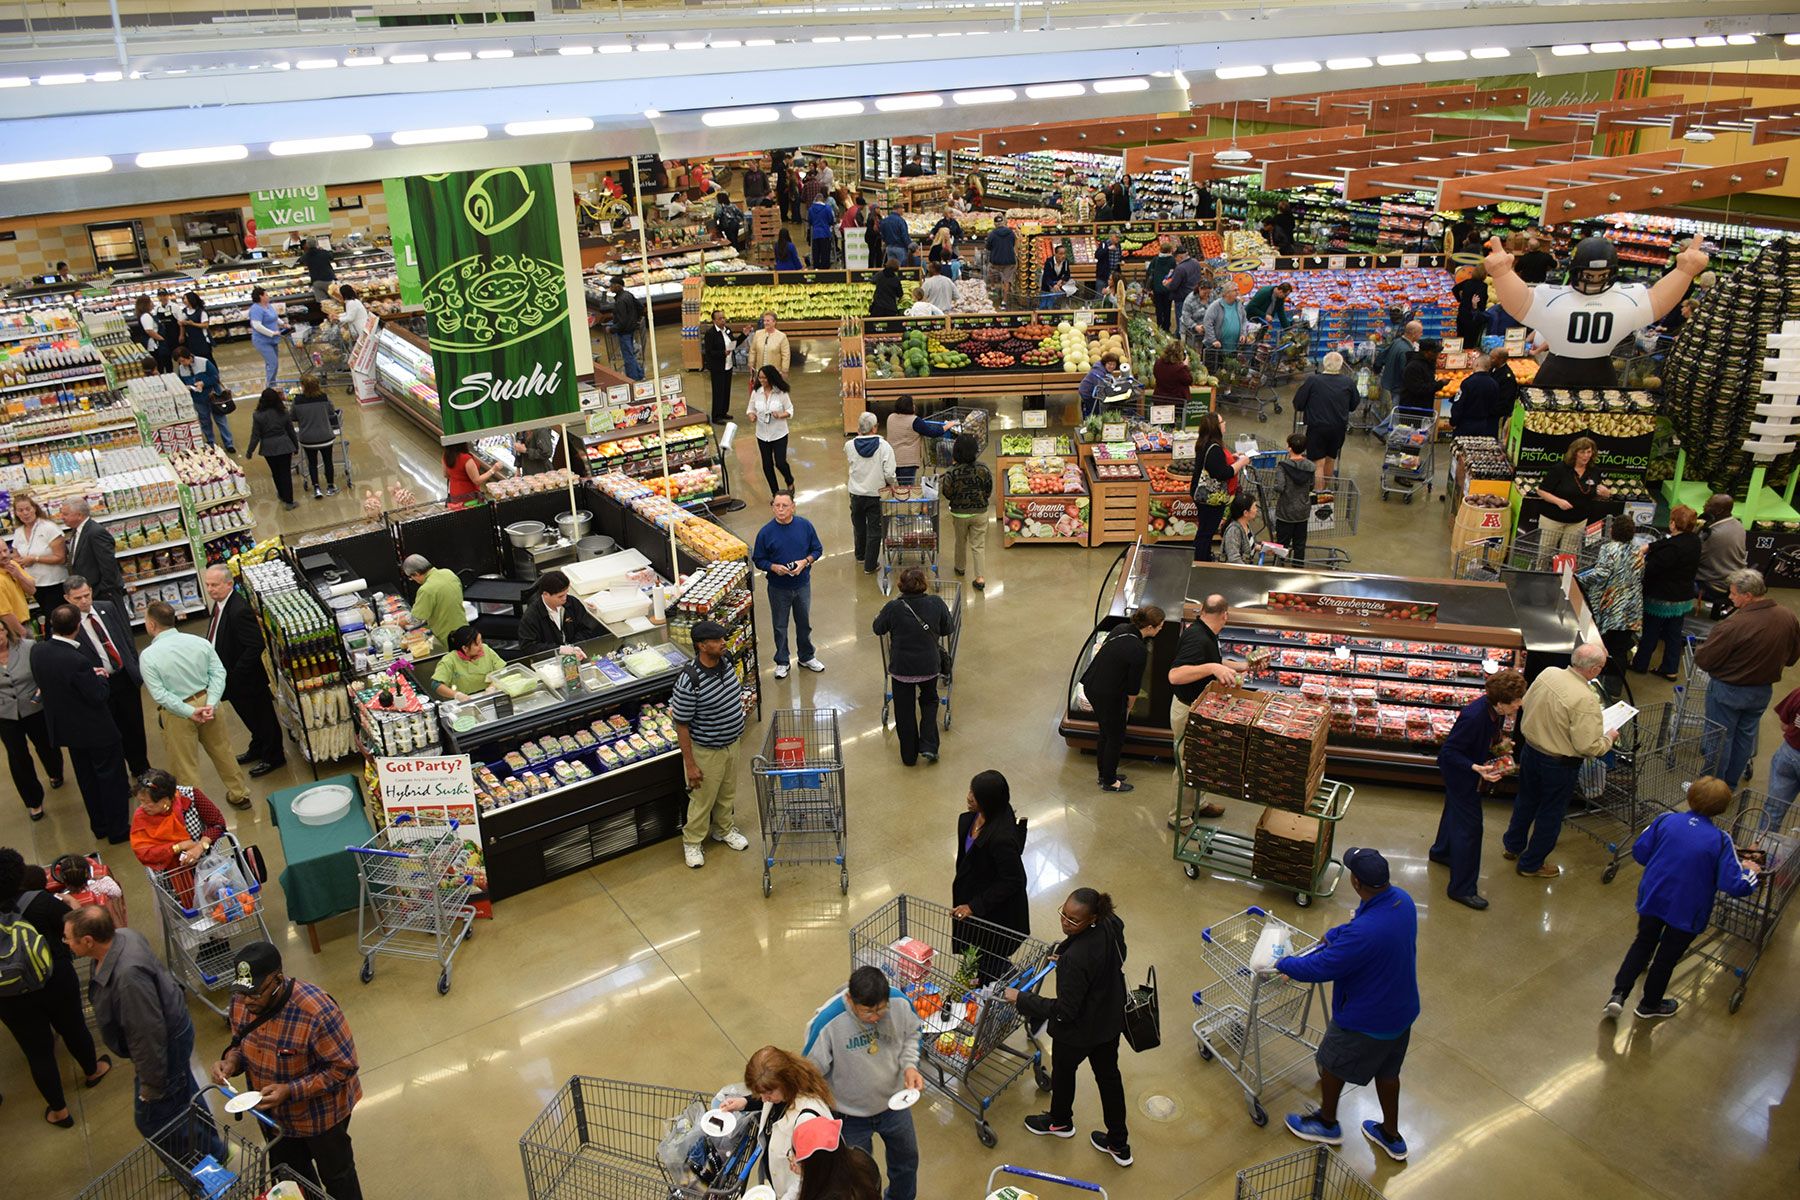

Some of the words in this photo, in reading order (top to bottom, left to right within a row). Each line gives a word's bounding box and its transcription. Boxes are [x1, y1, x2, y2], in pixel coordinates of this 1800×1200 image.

[268, 205, 316, 225] Well
[1567, 311, 1614, 344] 00
[448, 360, 563, 411] Sushi
[1520, 451, 1565, 462] PISTACH
[1594, 454, 1649, 466] STACHIOS
[183, 491, 196, 529] LIVING
[1027, 501, 1066, 514] Organic
[1171, 500, 1197, 513] Orga
[1317, 596, 1386, 610] Strawberries
[386, 761, 413, 772] Got
[416, 759, 462, 774] Party?
[386, 784, 430, 801] Hybrid
[435, 783, 469, 796] Sushi
